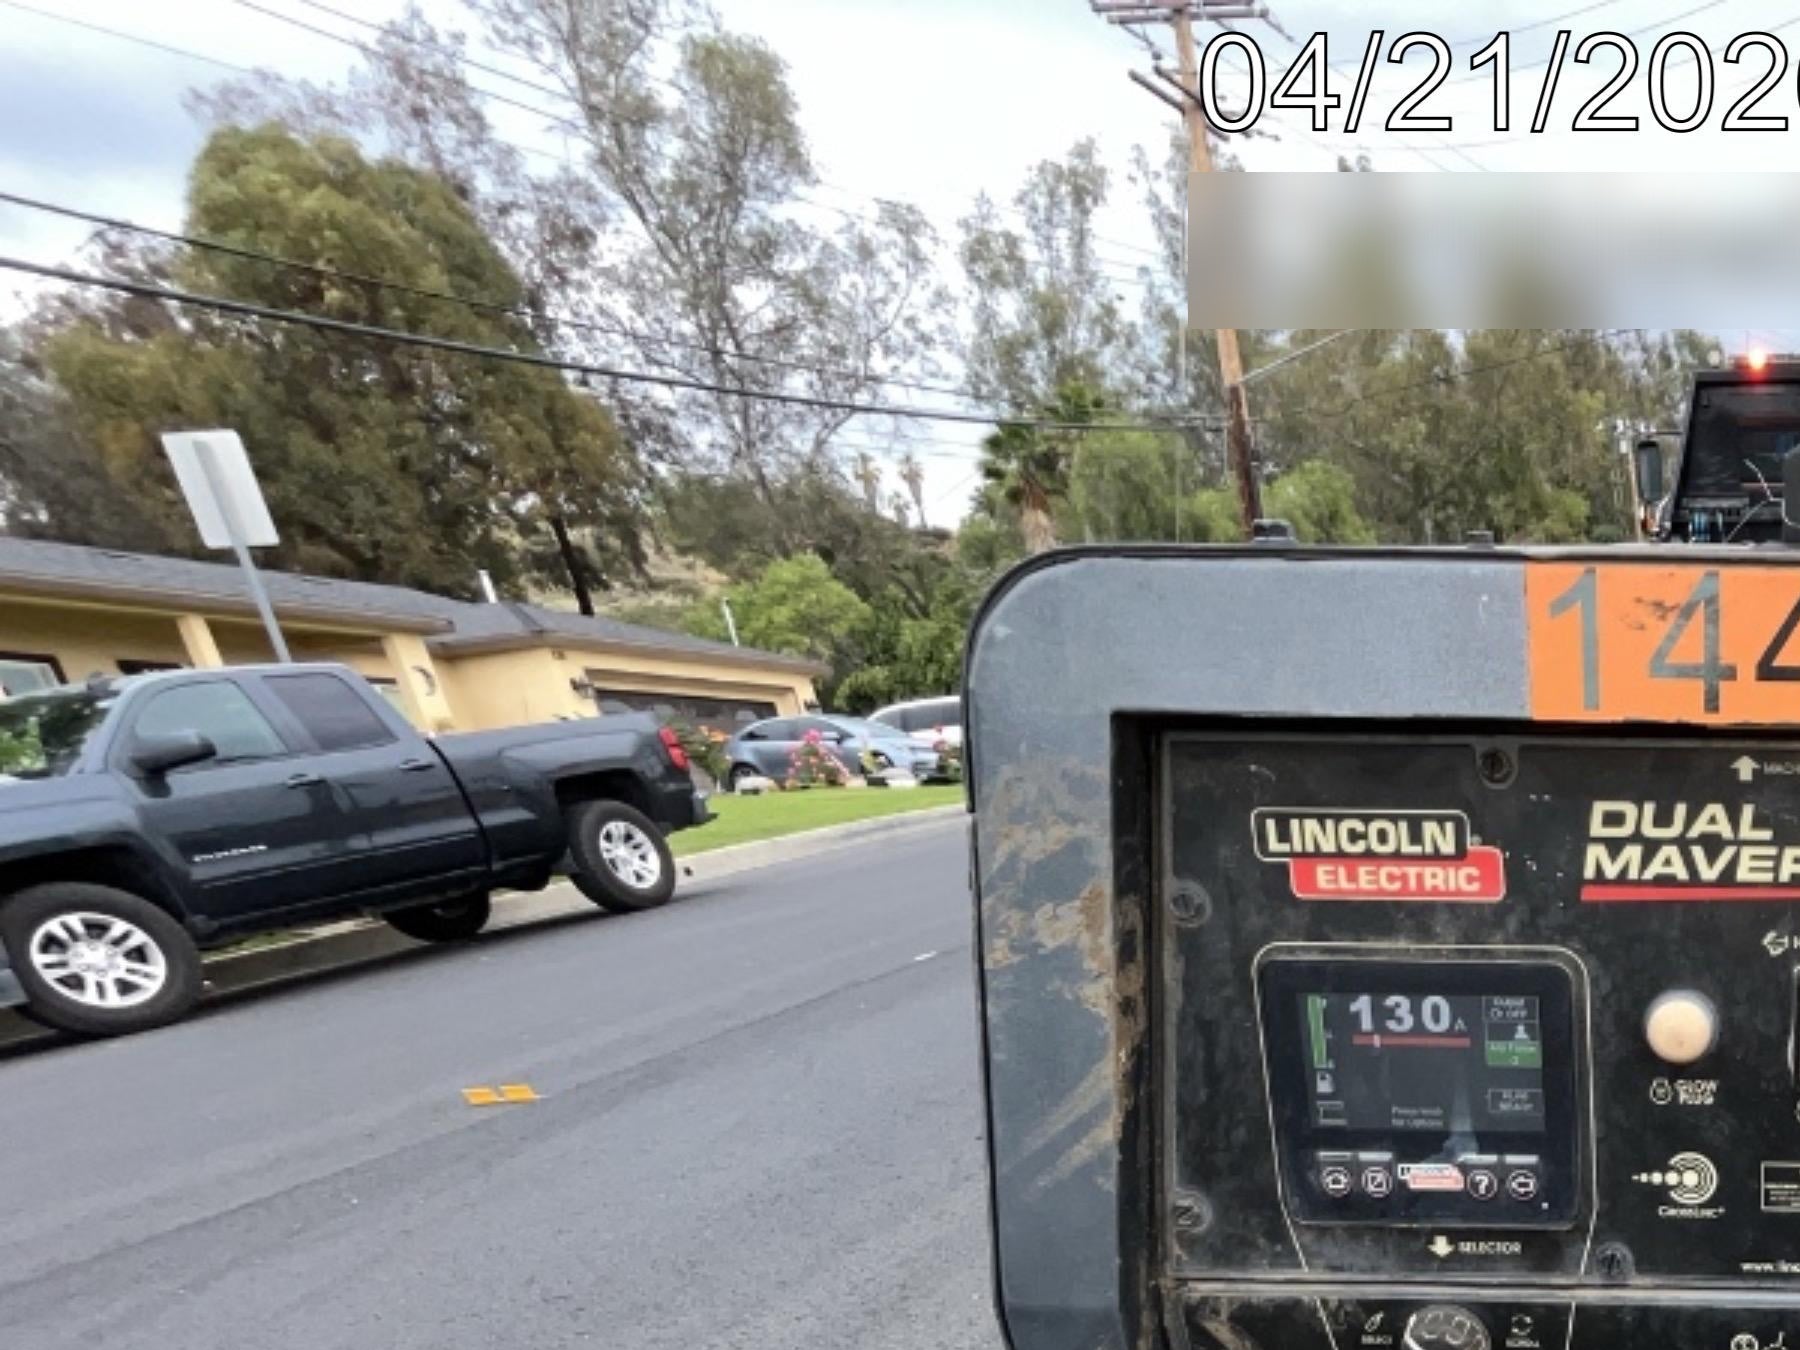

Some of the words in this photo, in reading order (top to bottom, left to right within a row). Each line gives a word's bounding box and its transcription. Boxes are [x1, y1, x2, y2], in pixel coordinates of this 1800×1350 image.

[1265, 818, 1456, 855] LINCOLN
[1589, 800, 1774, 840] DUAL
[1316, 864, 1481, 893] ELECTRIC
[1350, 995, 1450, 1033] 130
